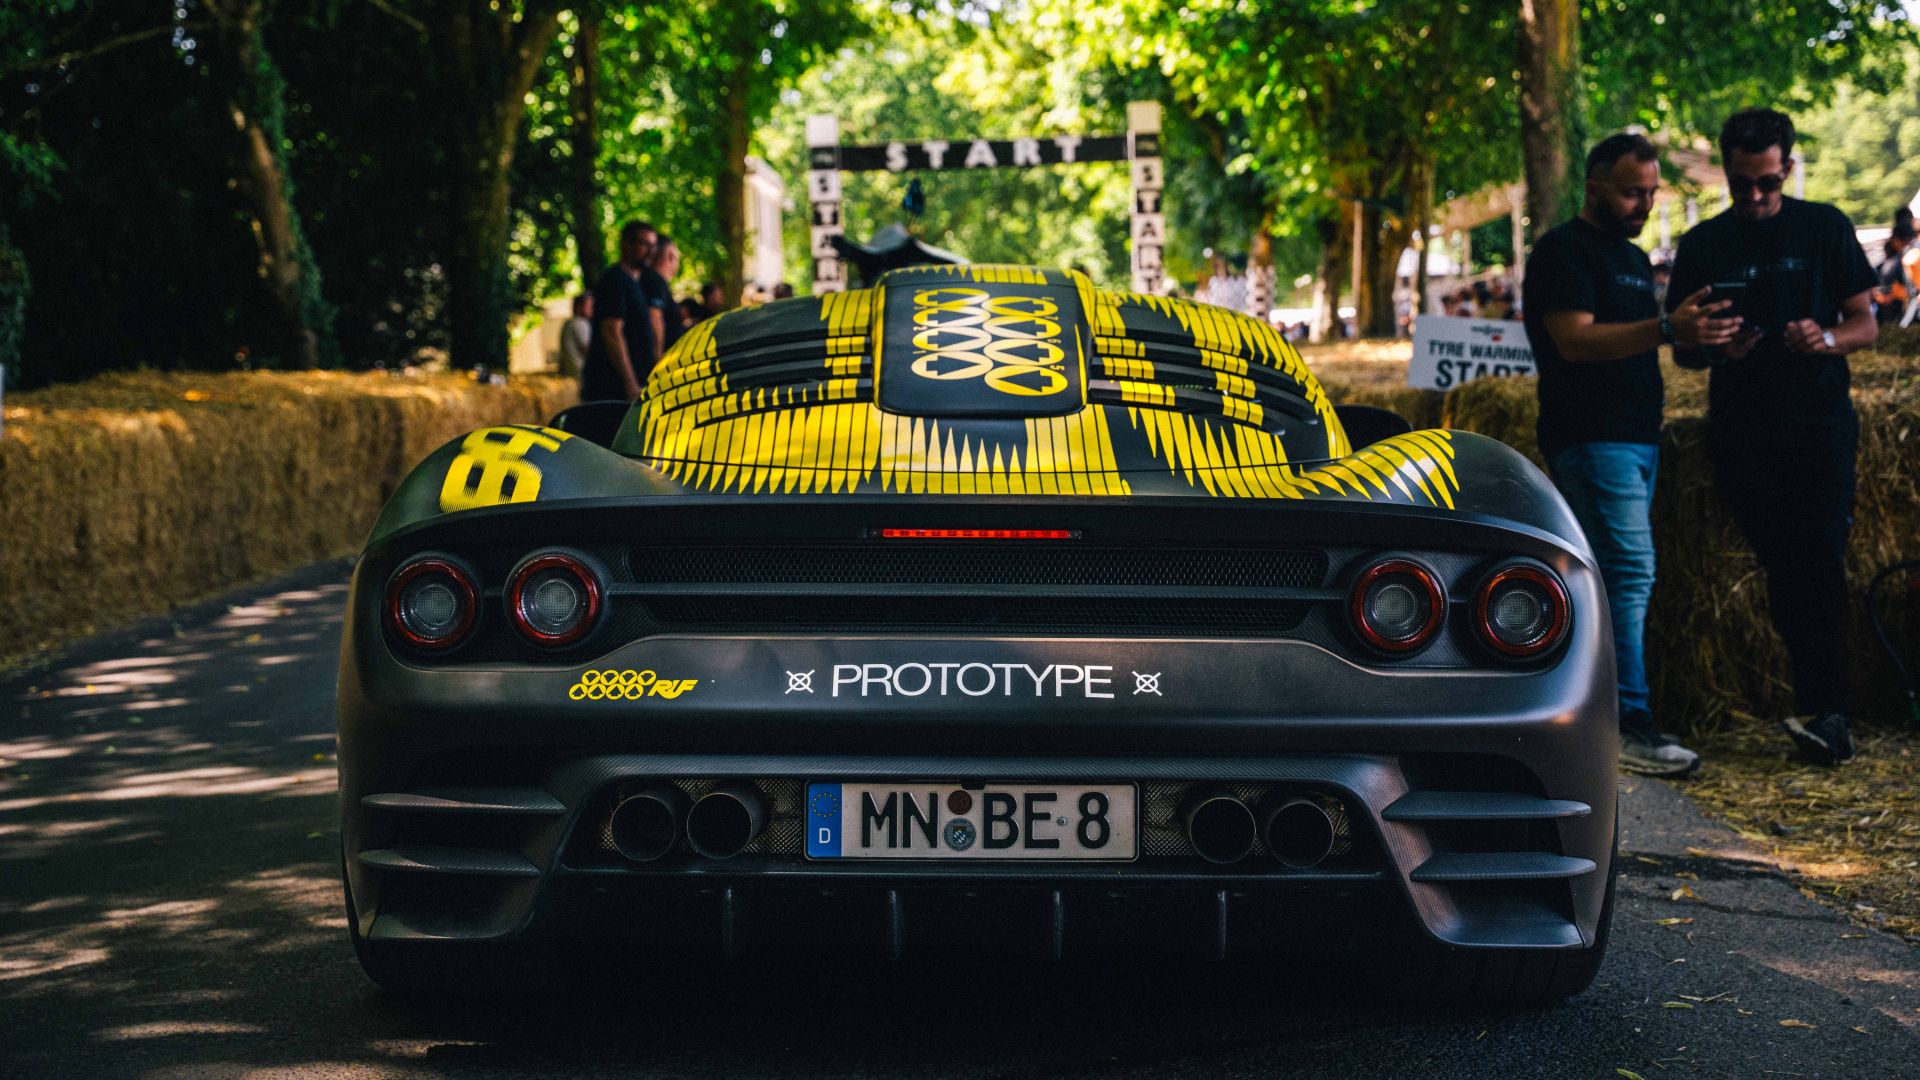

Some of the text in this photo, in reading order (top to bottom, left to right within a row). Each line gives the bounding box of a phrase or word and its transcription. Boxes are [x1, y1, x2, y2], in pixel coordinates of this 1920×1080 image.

[886, 136, 1082, 172] START
[1428, 339, 1534, 361] TYRE WARMIN
[647, 680, 698, 699] RUF
[832, 662, 1115, 699] PROTOTYPE
[862, 792, 938, 849] MN
[983, 792, 1059, 849] BE
[1077, 792, 1111, 849] 8
[818, 828, 831, 844] D
